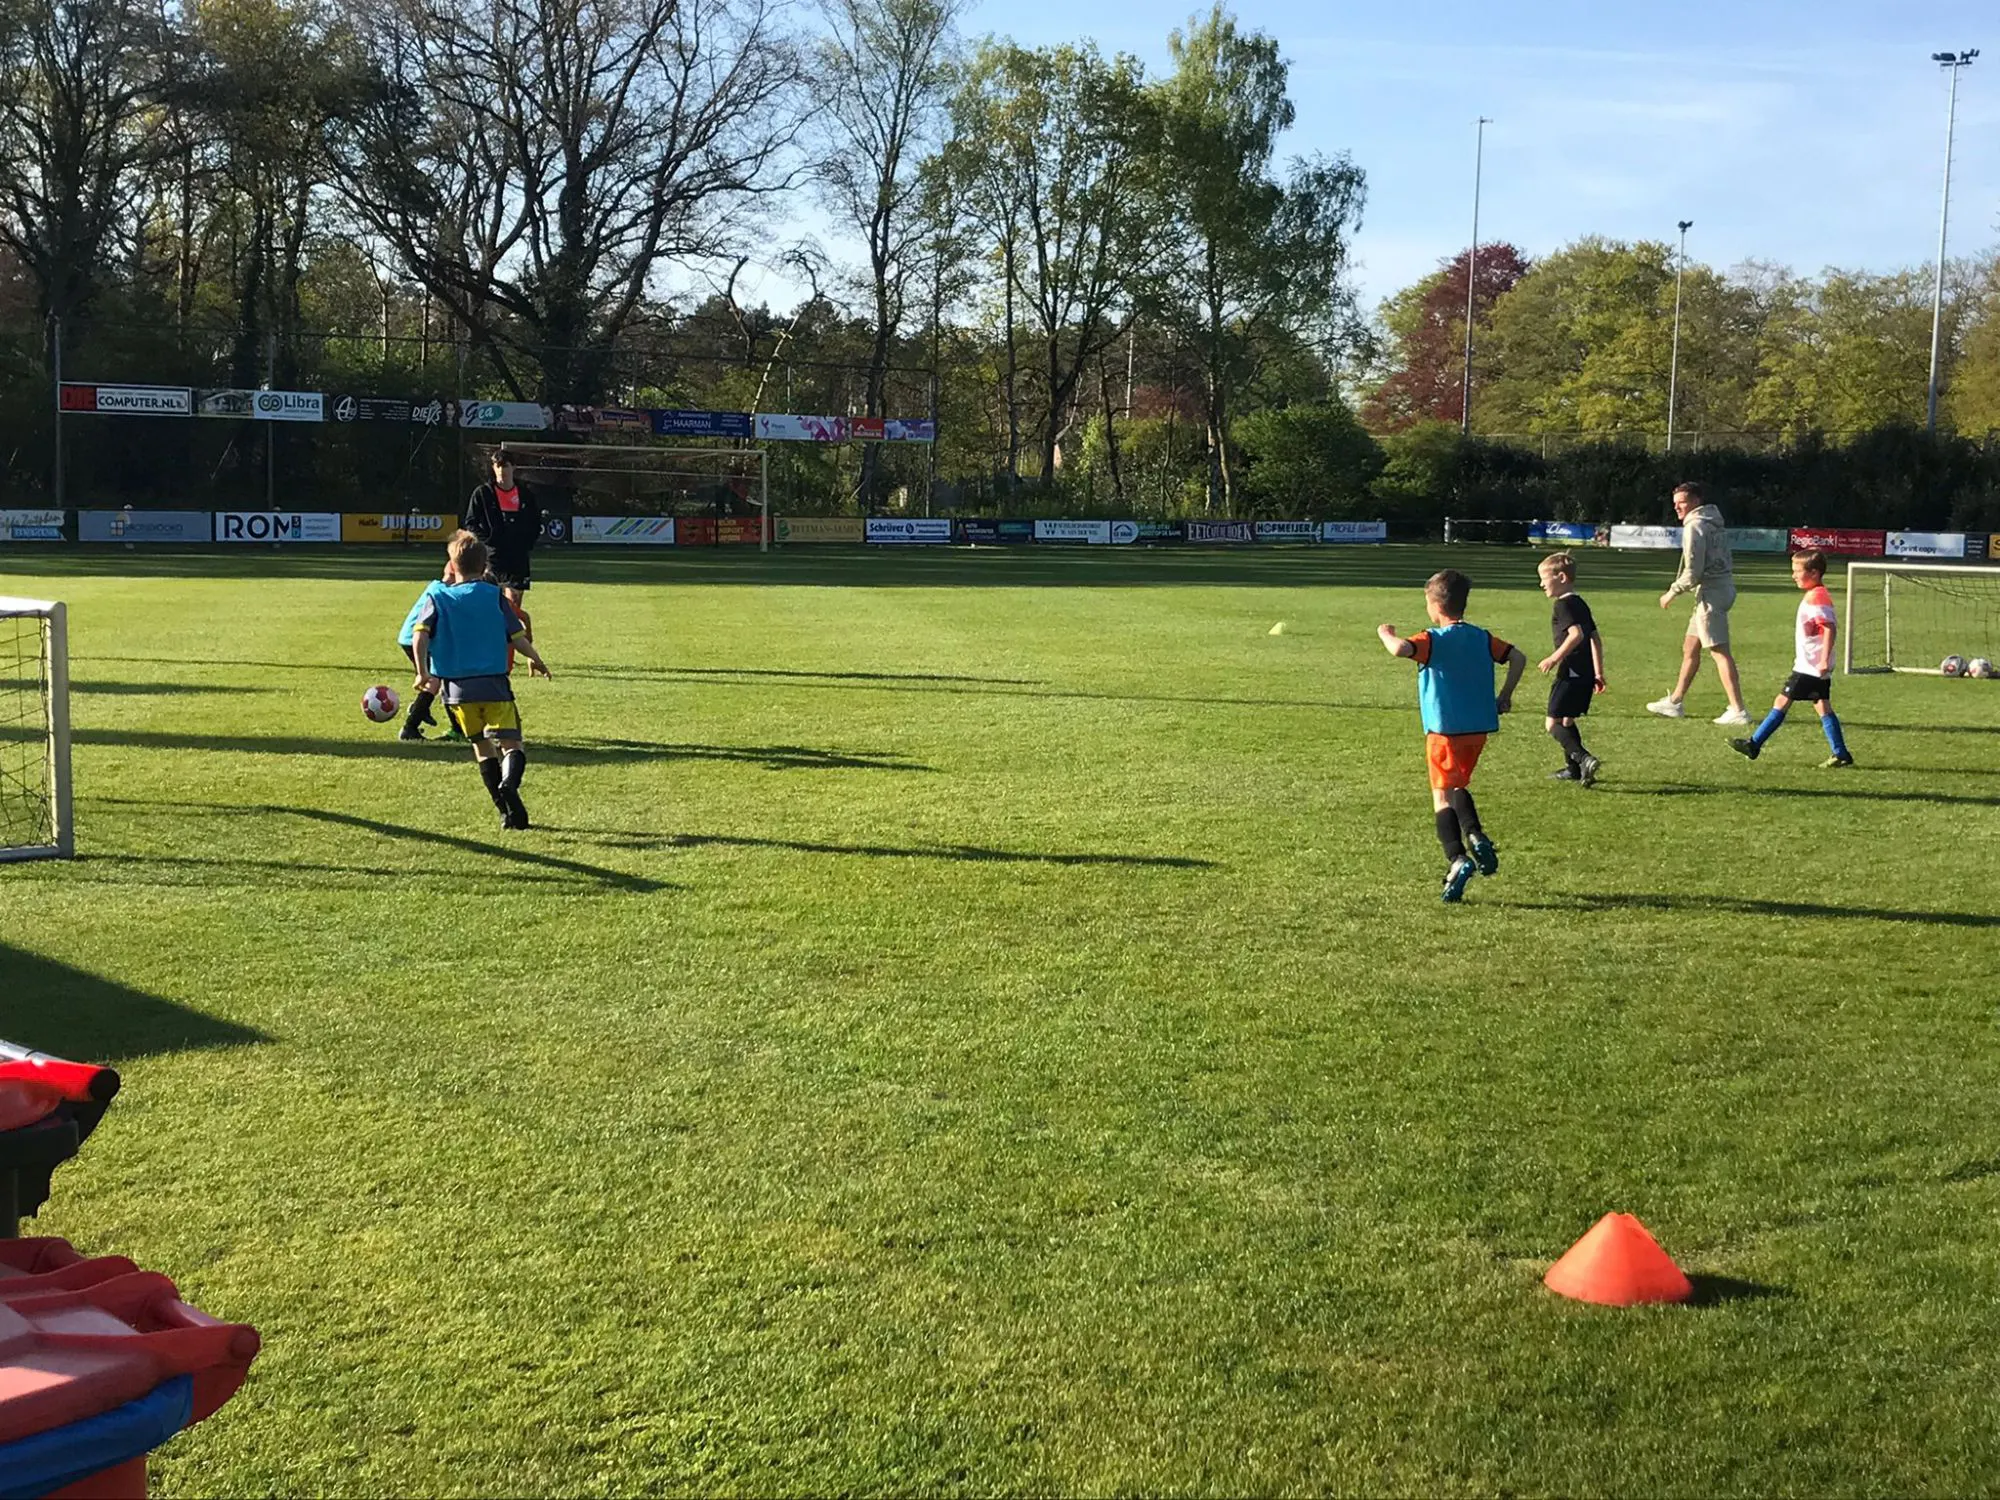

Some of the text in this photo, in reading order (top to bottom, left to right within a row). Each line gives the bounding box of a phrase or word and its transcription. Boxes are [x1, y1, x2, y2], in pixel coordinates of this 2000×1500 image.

[98, 396, 177, 409] COMPUTER.NL
[284, 395, 320, 409] Libra
[673, 419, 711, 429] HAARMAN
[224, 515, 290, 539] ROM
[380, 515, 443, 529] JUMBO
[1257, 523, 1311, 533] HOFMEIJER
[1791, 534, 1834, 548] RegioBank
